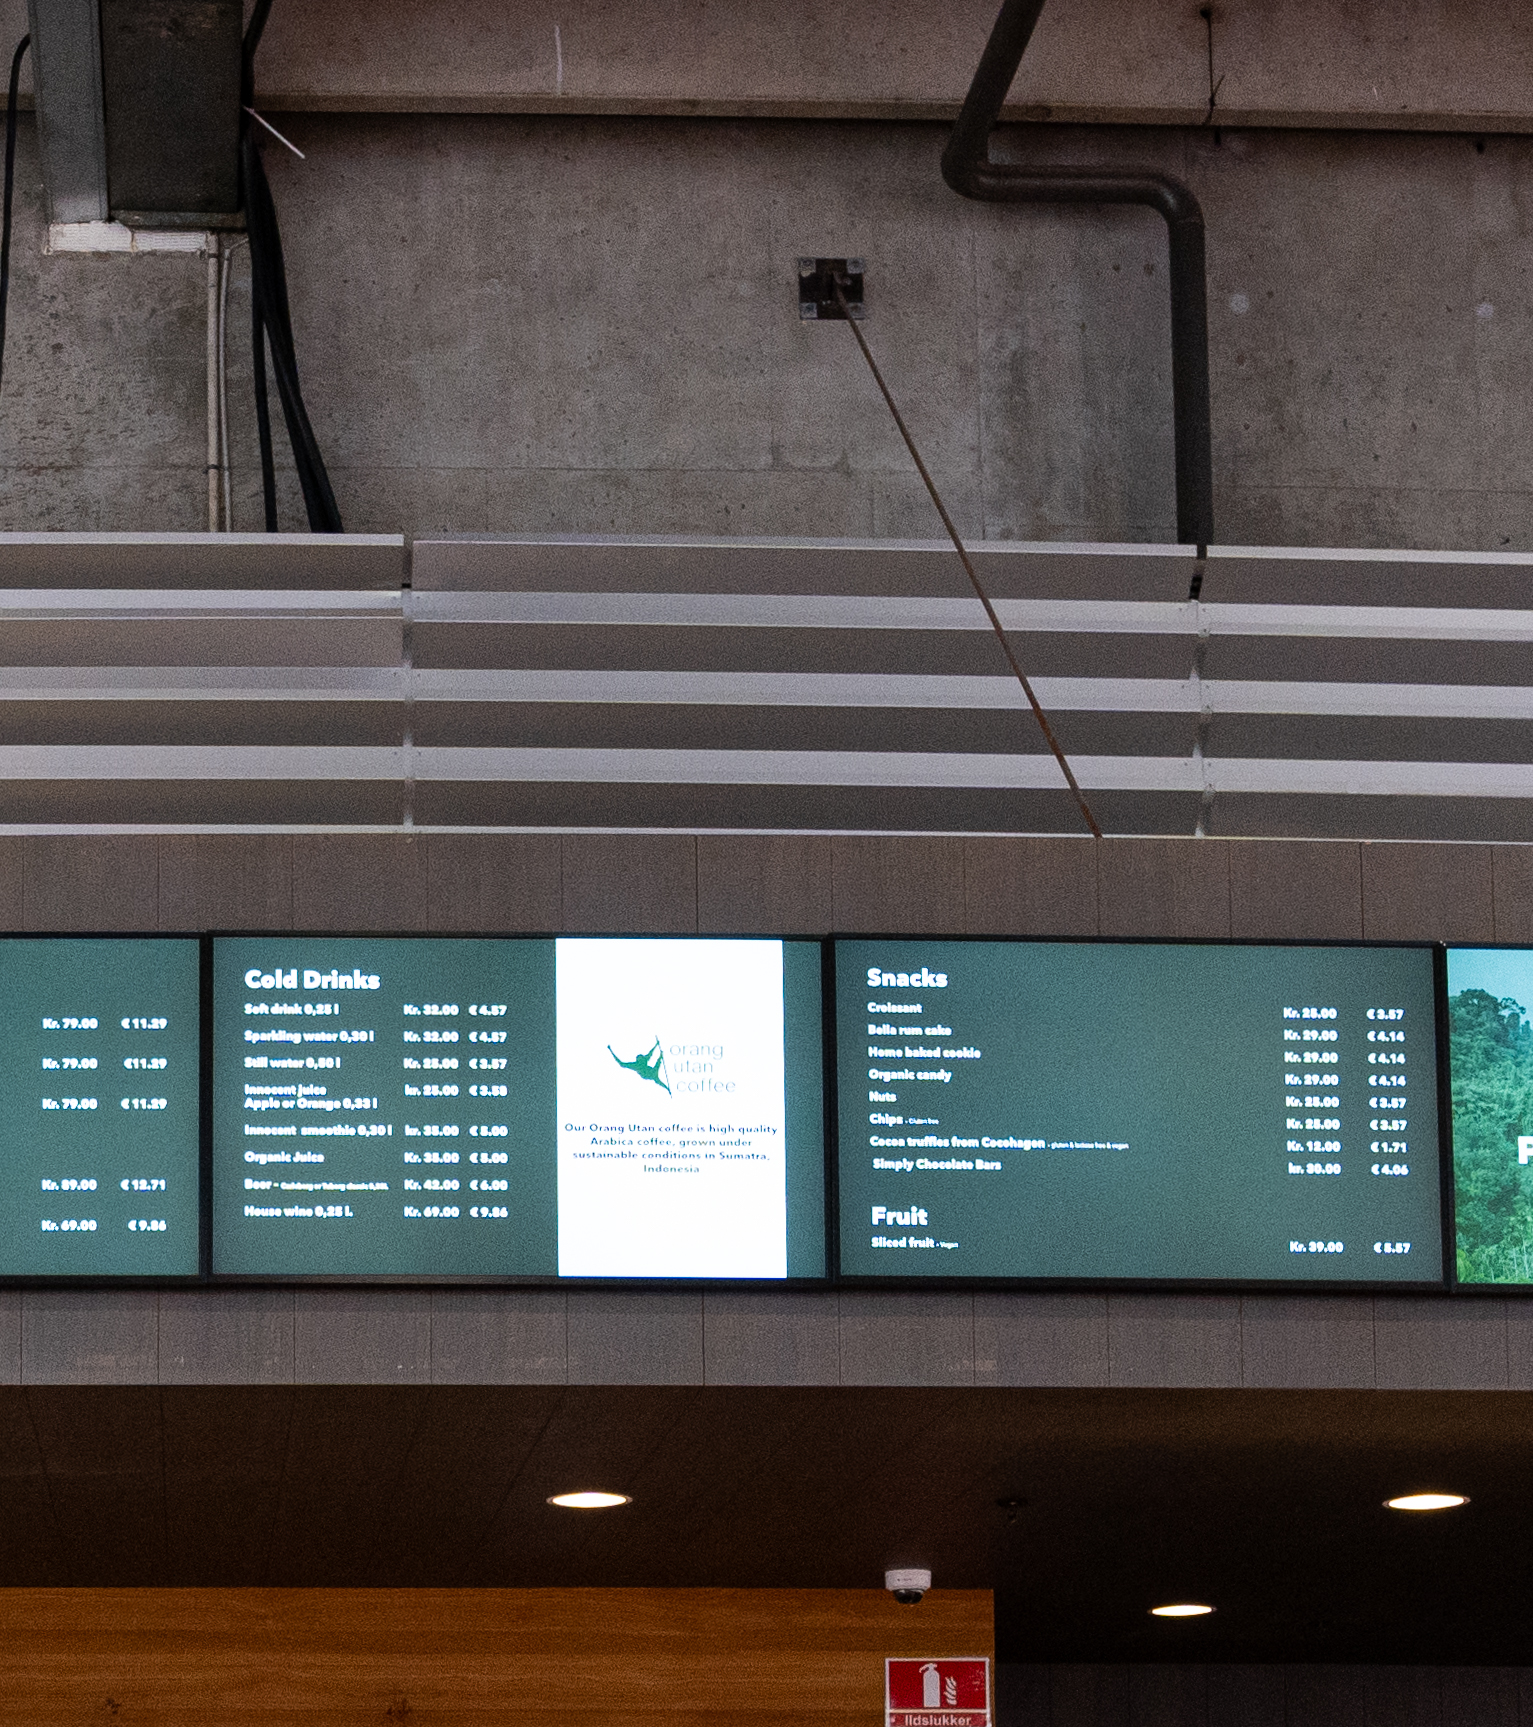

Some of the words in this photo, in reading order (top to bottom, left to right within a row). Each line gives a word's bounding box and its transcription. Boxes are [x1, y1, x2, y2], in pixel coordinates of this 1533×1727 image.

[244, 968, 298, 989] Cold
[303, 969, 381, 990] Drinks
[867, 967, 948, 988] Snacks
[871, 1205, 928, 1226] Fruit
[904, 1715, 972, 1727] Ildslukker
